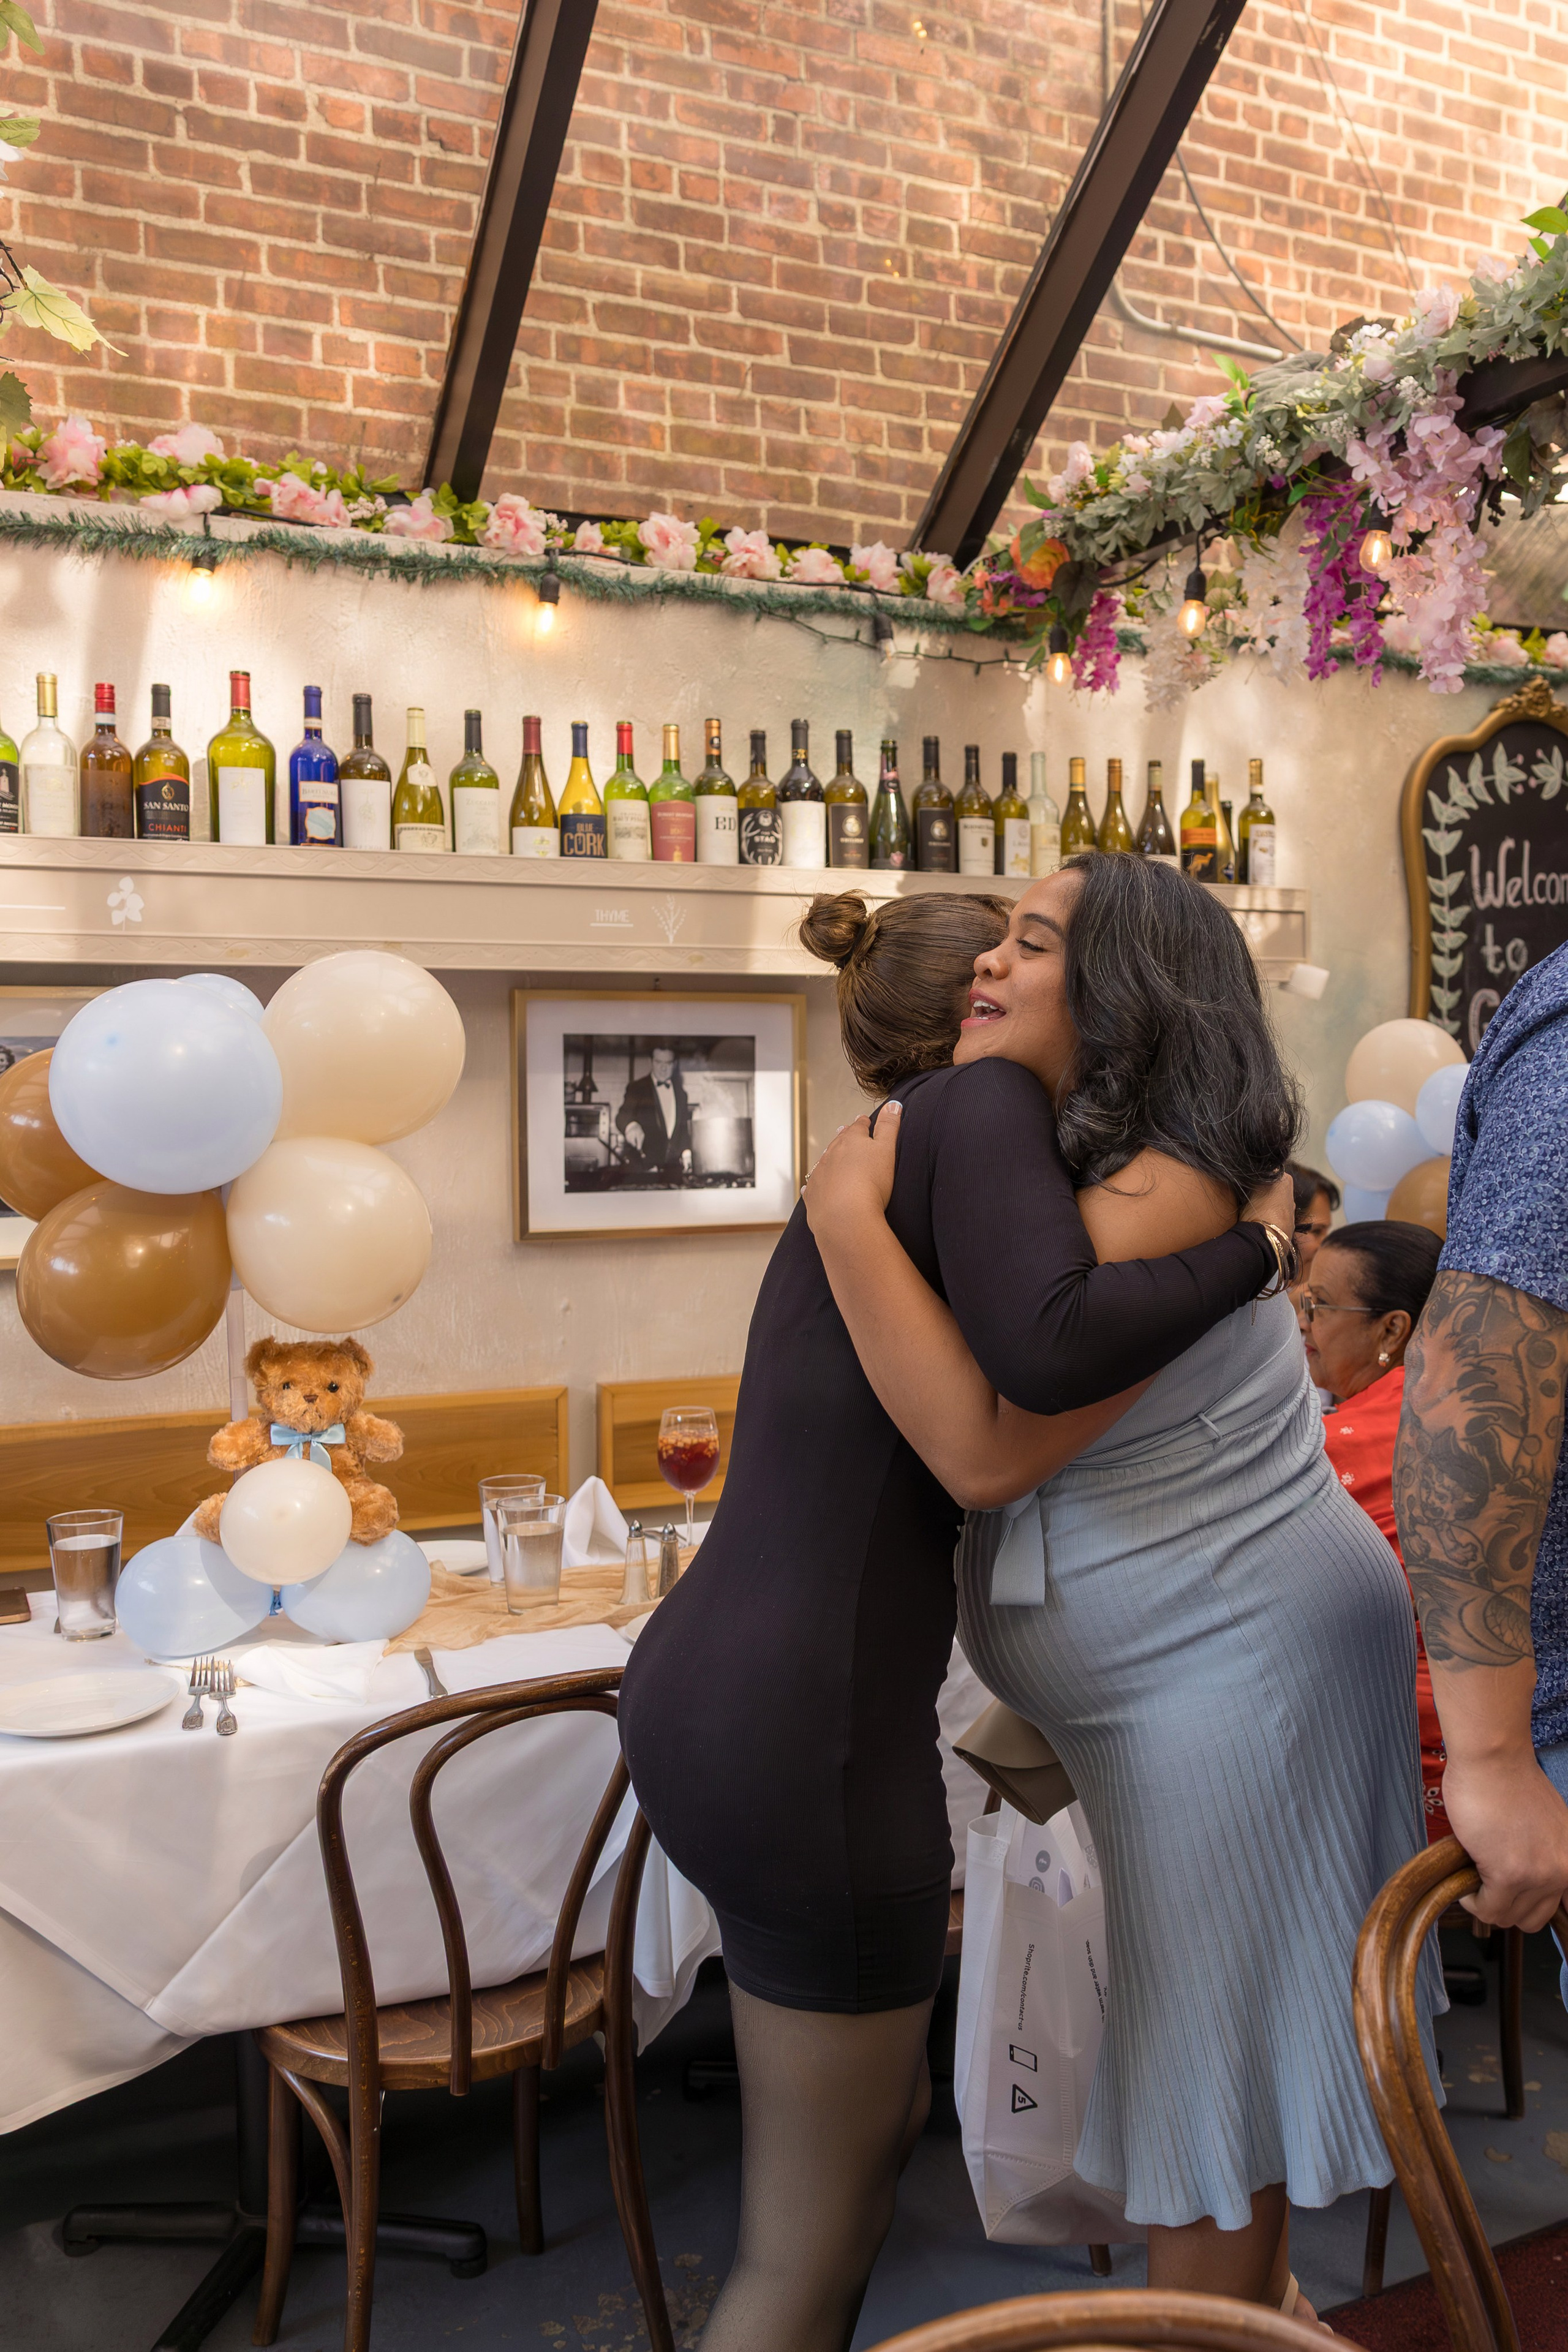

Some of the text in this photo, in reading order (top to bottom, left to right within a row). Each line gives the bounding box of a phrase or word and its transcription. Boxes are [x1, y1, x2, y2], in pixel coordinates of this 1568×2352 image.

[143, 801, 189, 812] SAN SANTO
[148, 823, 187, 833] CHIANTI
[576, 823, 594, 832] BLUE
[563, 832, 605, 856] CORK
[594, 909, 630, 923] THYME
[1480, 923, 1528, 974] to
[1017, 1943, 1035, 2031] Shoprite.com/contact-us
[1018, 2095, 1026, 2104] 5
